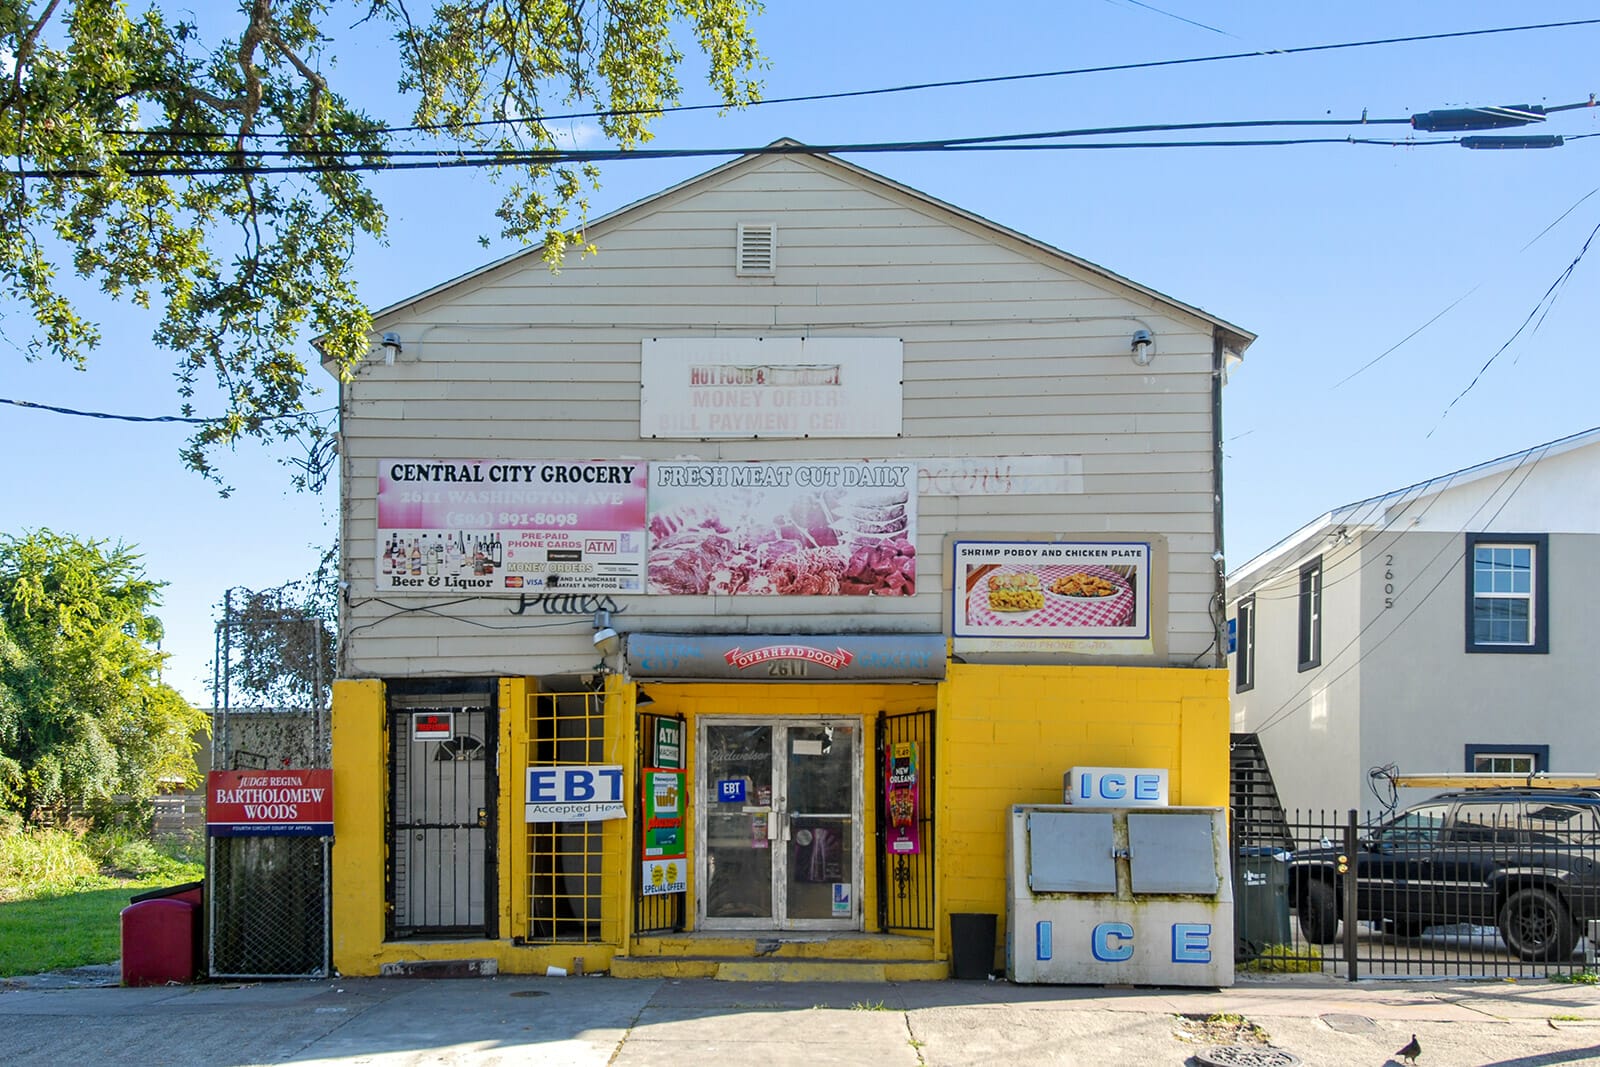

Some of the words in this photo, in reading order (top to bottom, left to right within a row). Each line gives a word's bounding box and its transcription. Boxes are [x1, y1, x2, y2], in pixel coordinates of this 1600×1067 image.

[691, 366, 715, 385] HOT
[692, 390, 764, 408] MONEY
[659, 413, 700, 432] BILL
[708, 413, 798, 432] PAYMENT
[810, 413, 876, 432] CEN
[390, 463, 485, 483] CENTRAL
[489, 464, 537, 483] CITY
[541, 465, 635, 484] GROCERY
[657, 466, 729, 487] FRESH
[731, 466, 792, 487] MEAT
[795, 466, 840, 487] CUT
[843, 466, 910, 487] DAILY
[400, 491, 441, 504] 2611
[447, 490, 581, 505] WASHINGTON
[584, 491, 623, 506] AVE
[446, 511, 494, 527] (504)
[498, 511, 578, 527] 891-8098
[521, 532, 569, 540] PRE-PAID
[507, 540, 544, 548] PHONE
[546, 540, 582, 549] CARDS
[587, 541, 615, 552] ATM
[961, 548, 1001, 557] SHRIMP
[1004, 548, 1038, 557] POBOY
[1041, 548, 1062, 557] AND
[1065, 549, 1108, 558] CHICKEN
[1111, 549, 1142, 558] PLATE
[506, 562, 546, 573] MONEY
[548, 562, 594, 573] ORDERS
[391, 576, 424, 587] Beer
[427, 576, 441, 587] &
[444, 576, 494, 589] Liquor
[526, 578, 543, 586] VISA
[1384, 554, 1394, 609] 2605
[631, 643, 704, 659] CENTRAL
[857, 650, 933, 670] GROCERY
[737, 645, 804, 666] OVERHEAD
[807, 650, 839, 667] DOOR
[768, 659, 807, 677] 2611
[659, 728, 679, 745] ATM
[895, 767, 909, 775] NEW
[238, 777, 268, 788] JUDGE
[270, 776, 303, 787] REGINA
[529, 769, 624, 802] EBT
[723, 782, 740, 794] EBT
[1080, 773, 1160, 800] ICE
[215, 788, 325, 803] BARTHOLOMEW
[244, 804, 298, 819] WOODS
[533, 804, 591, 815] Accepted
[1036, 920, 1212, 964] ICE
